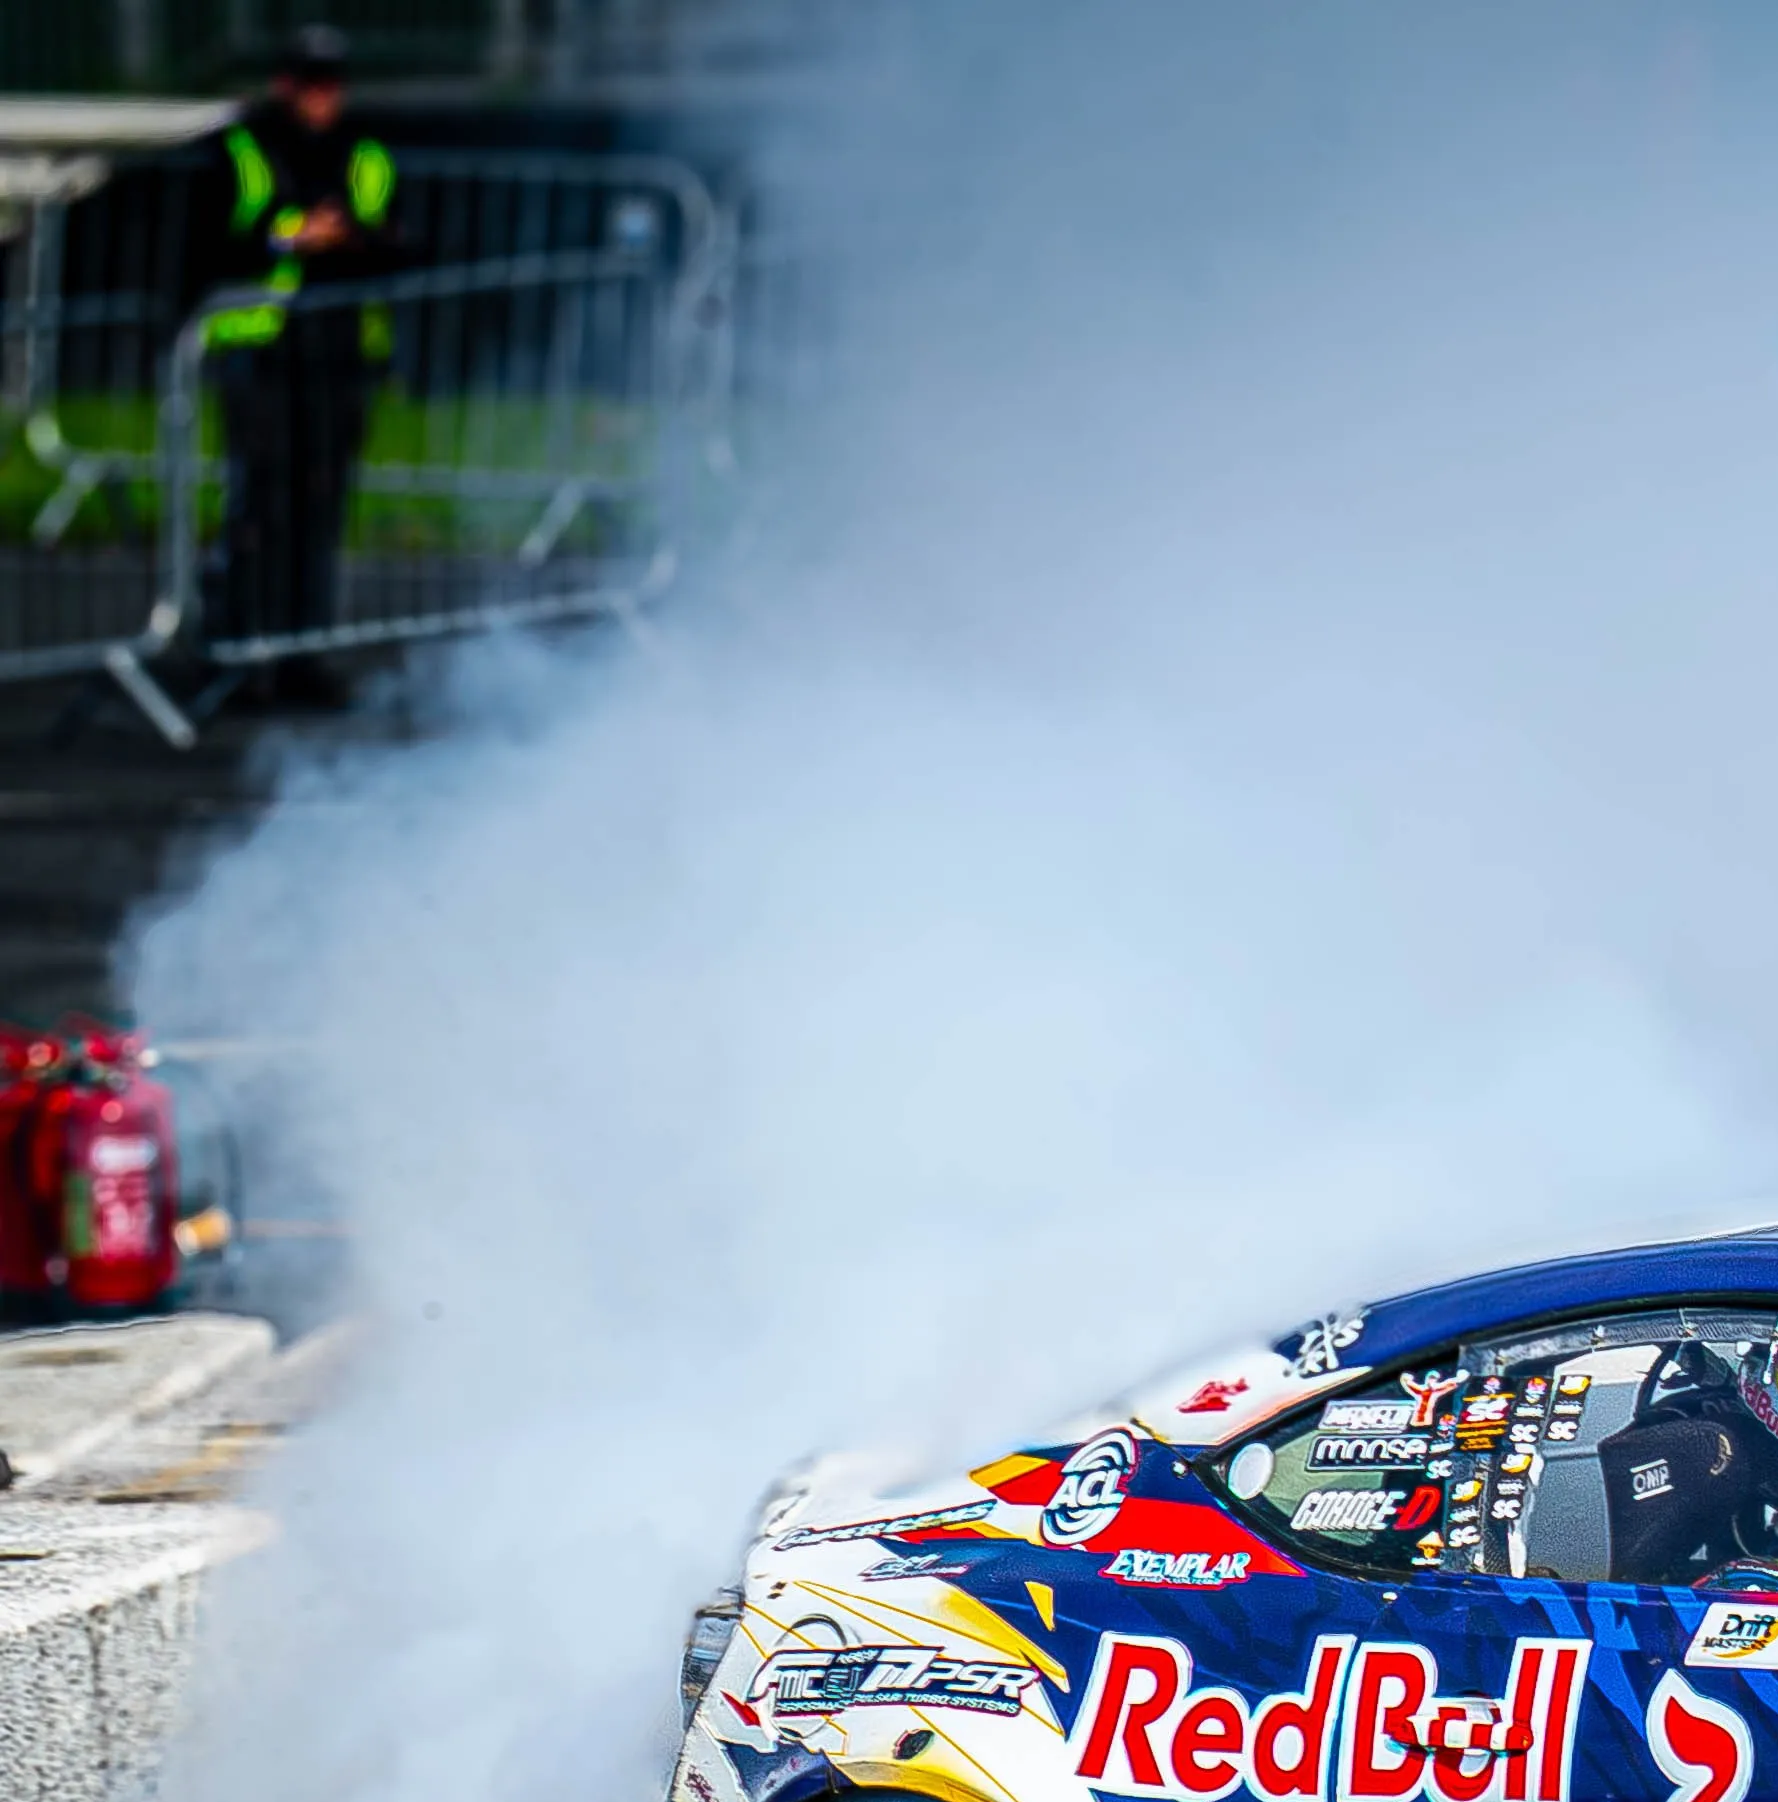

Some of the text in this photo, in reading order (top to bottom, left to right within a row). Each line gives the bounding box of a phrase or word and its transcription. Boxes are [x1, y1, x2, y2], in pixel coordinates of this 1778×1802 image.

[1509, 1423, 1539, 1442] SC
[1547, 1421, 1578, 1440] SC
[1426, 1459, 1453, 1479] SC
[1633, 1465, 1671, 1493] OMP
[1046, 1468, 1127, 1509] ACL
[1491, 1499, 1521, 1518] SC
[1449, 1525, 1481, 1548] SC
[1104, 1550, 1251, 1579] EXEMPLAR
[934, 1660, 1036, 1697] PSR
[951, 1695, 1019, 1715] SYSTEMS
